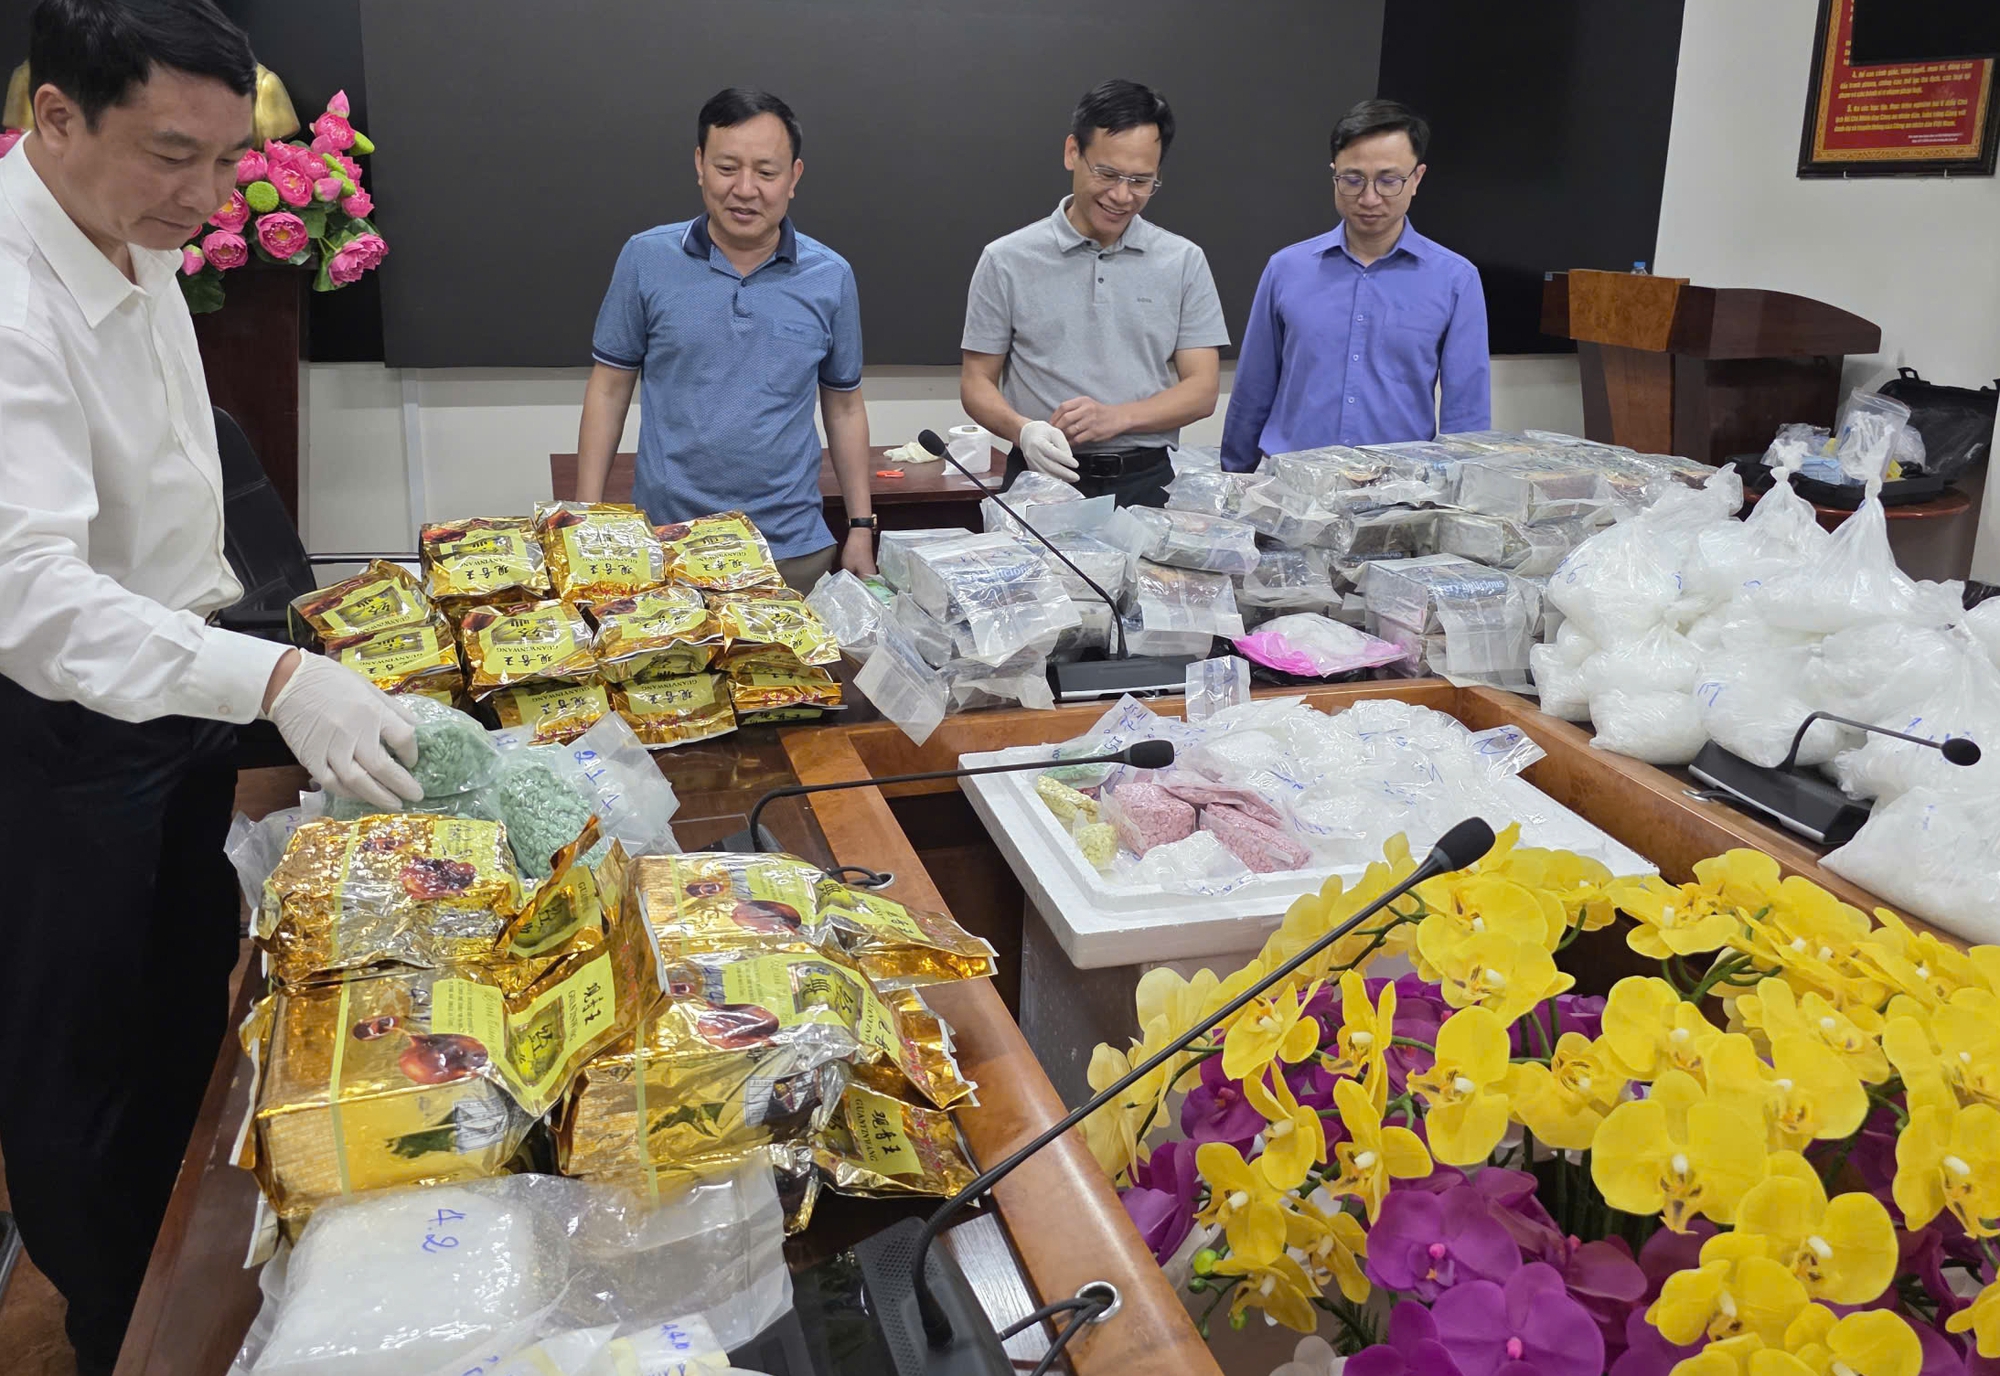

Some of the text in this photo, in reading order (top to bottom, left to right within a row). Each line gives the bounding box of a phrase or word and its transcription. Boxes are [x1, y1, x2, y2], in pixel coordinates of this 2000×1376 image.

[855, 1098, 878, 1162] GUANYINWANG
[871, 1109, 902, 1155] 观音王
[421, 1207, 467, 1254] 4.2
